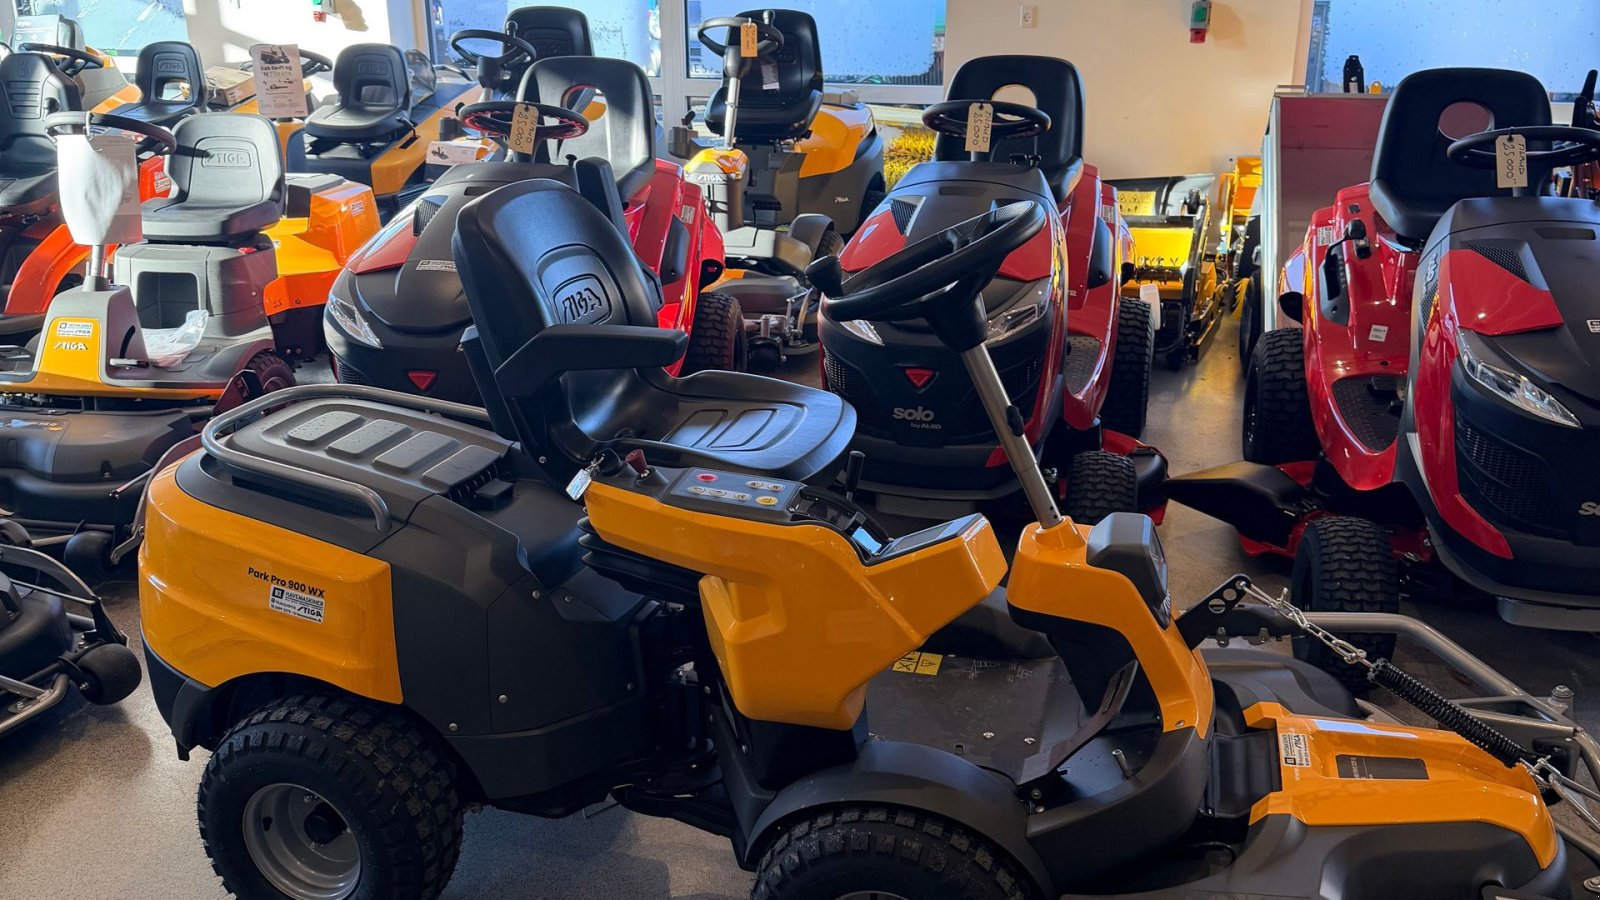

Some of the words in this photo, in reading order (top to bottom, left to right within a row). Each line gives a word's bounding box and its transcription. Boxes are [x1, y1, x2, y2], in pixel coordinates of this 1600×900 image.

[54, 342, 88, 351] STIGA
[892, 406, 934, 421] solo
[248, 567, 269, 582] Park
[271, 575, 286, 587] Pro
[288, 580, 306, 592] 900
[308, 586, 325, 598] WX
[297, 606, 323, 618] STIGA
